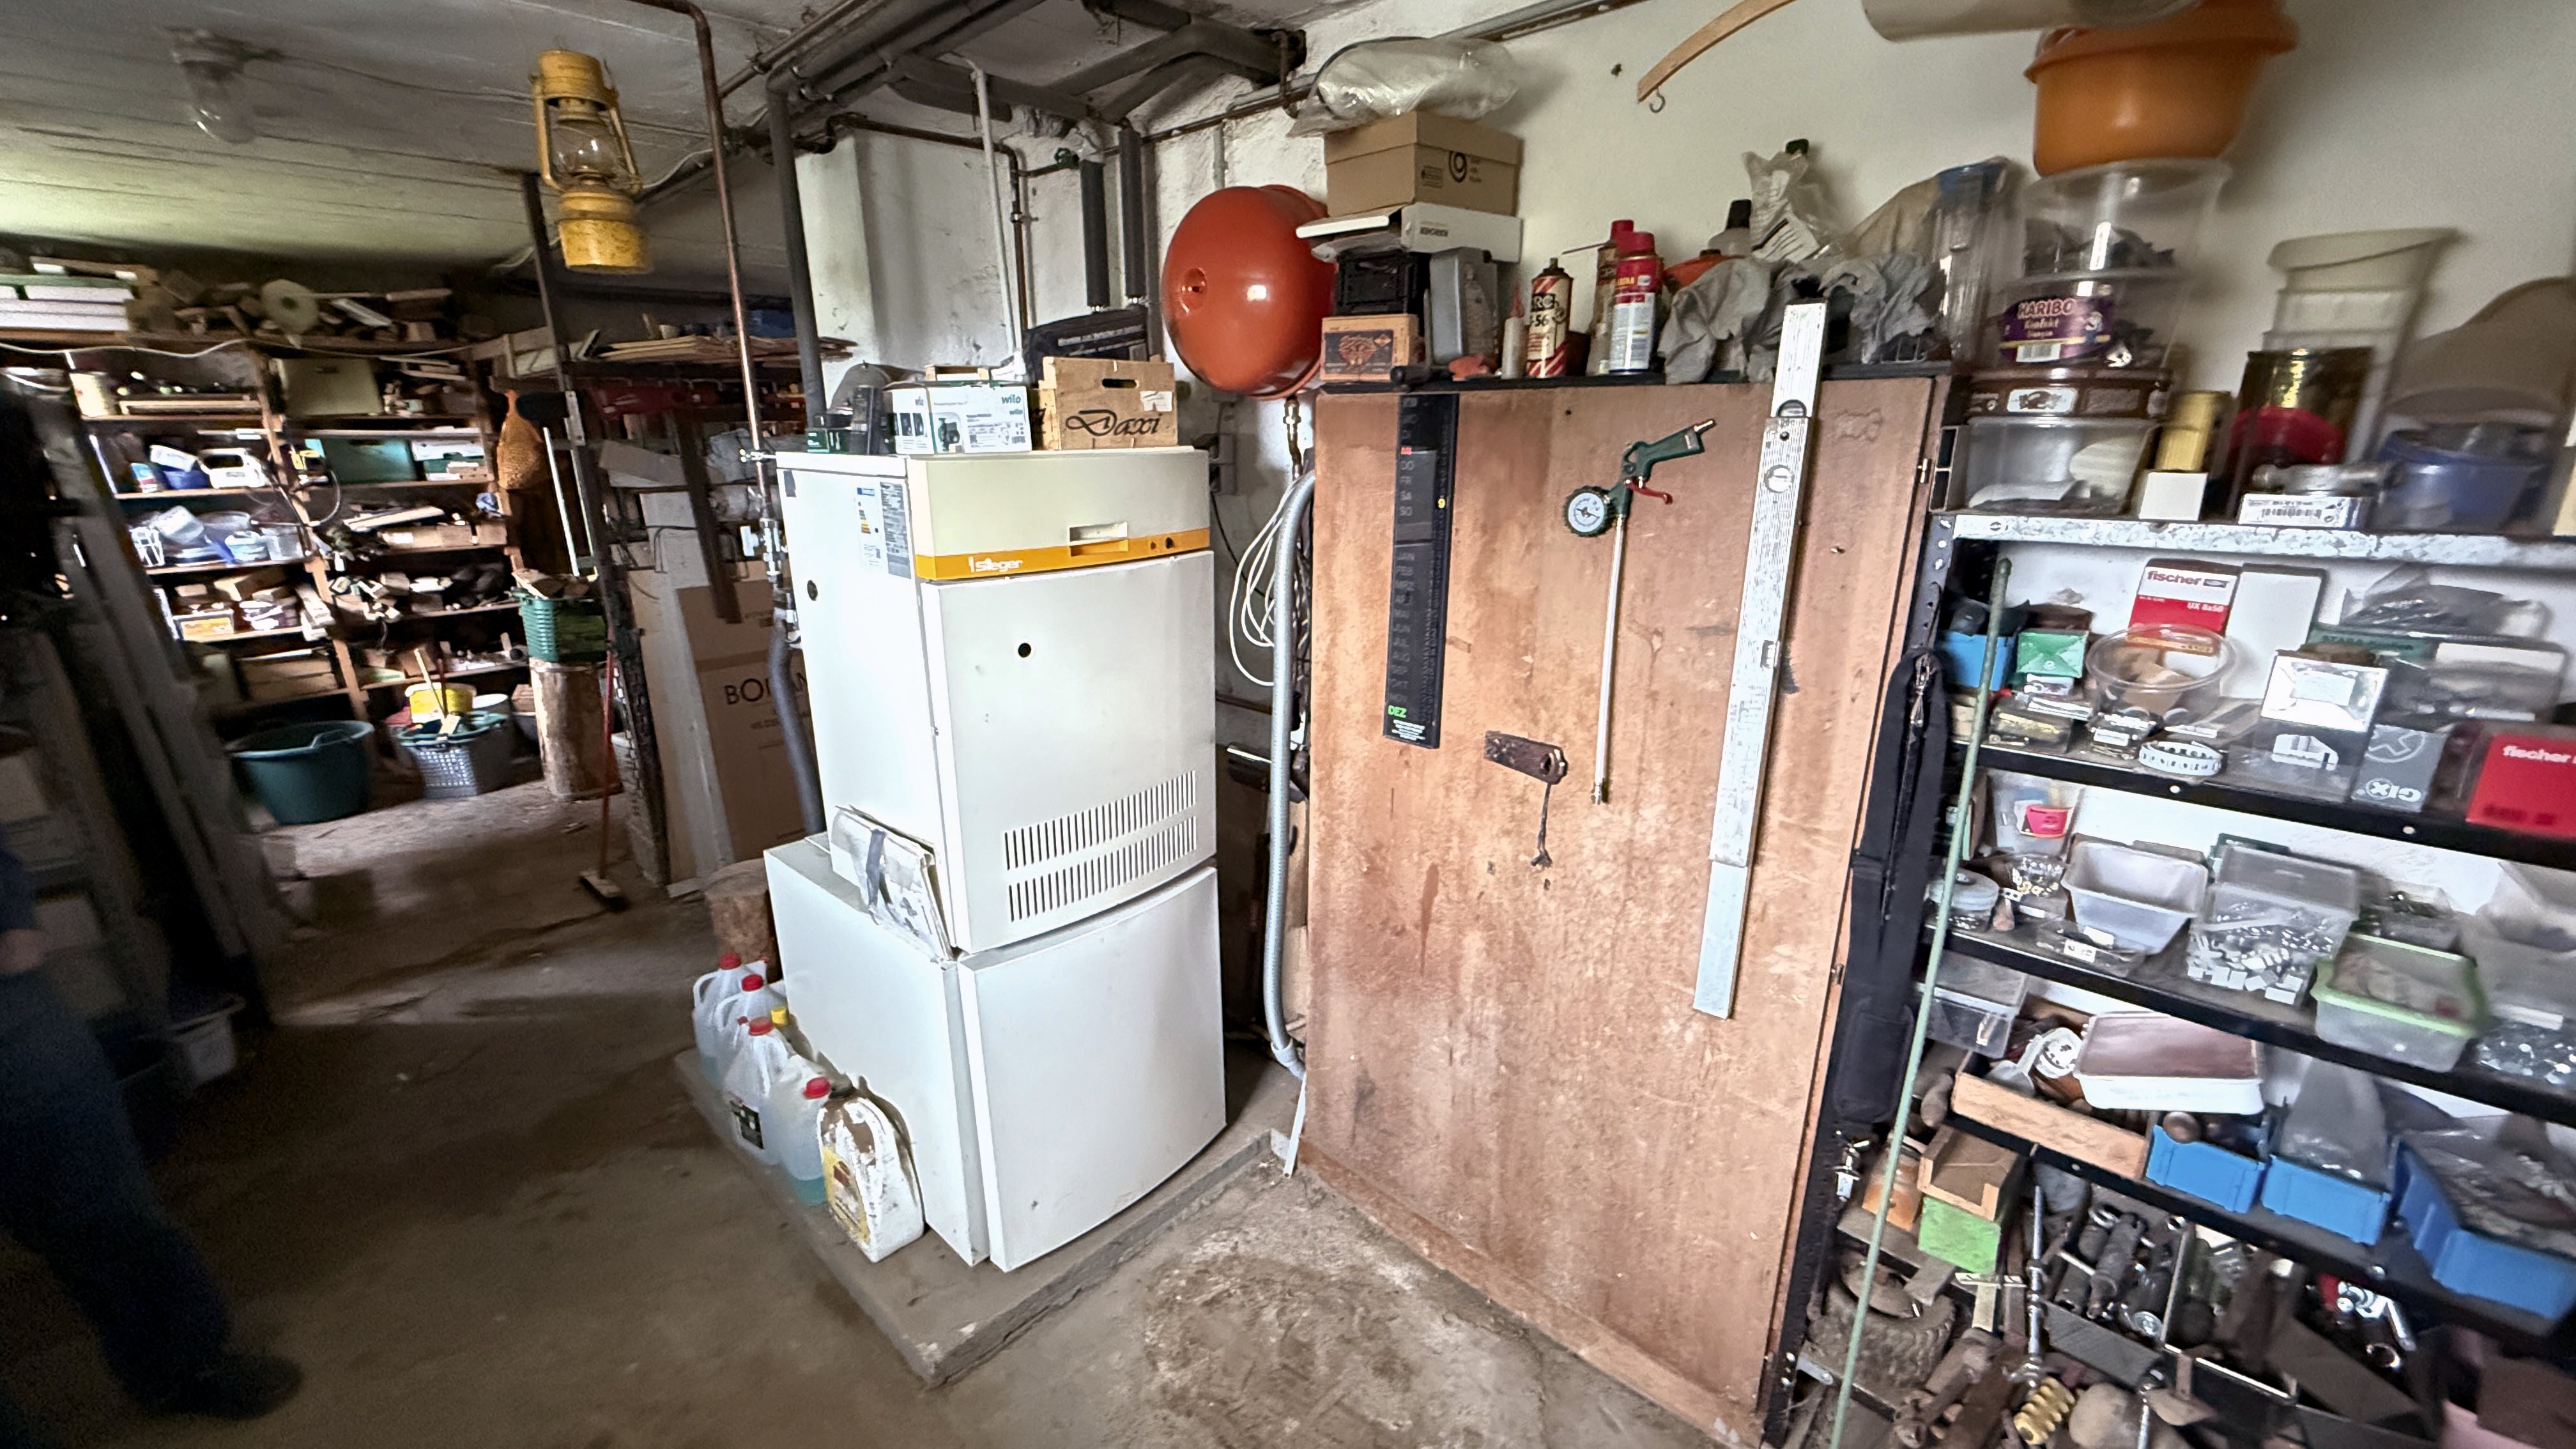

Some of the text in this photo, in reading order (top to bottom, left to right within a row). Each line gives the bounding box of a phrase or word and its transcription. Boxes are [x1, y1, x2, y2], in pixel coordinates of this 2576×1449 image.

[1533, 294, 1555, 310] RC
[2018, 298, 2076, 319] HARIBO
[1001, 394, 1021, 404] wilo
[2147, 571, 2202, 586] fischer
[1388, 705, 1407, 718] DEZ
[2503, 745, 2572, 763] fischer
